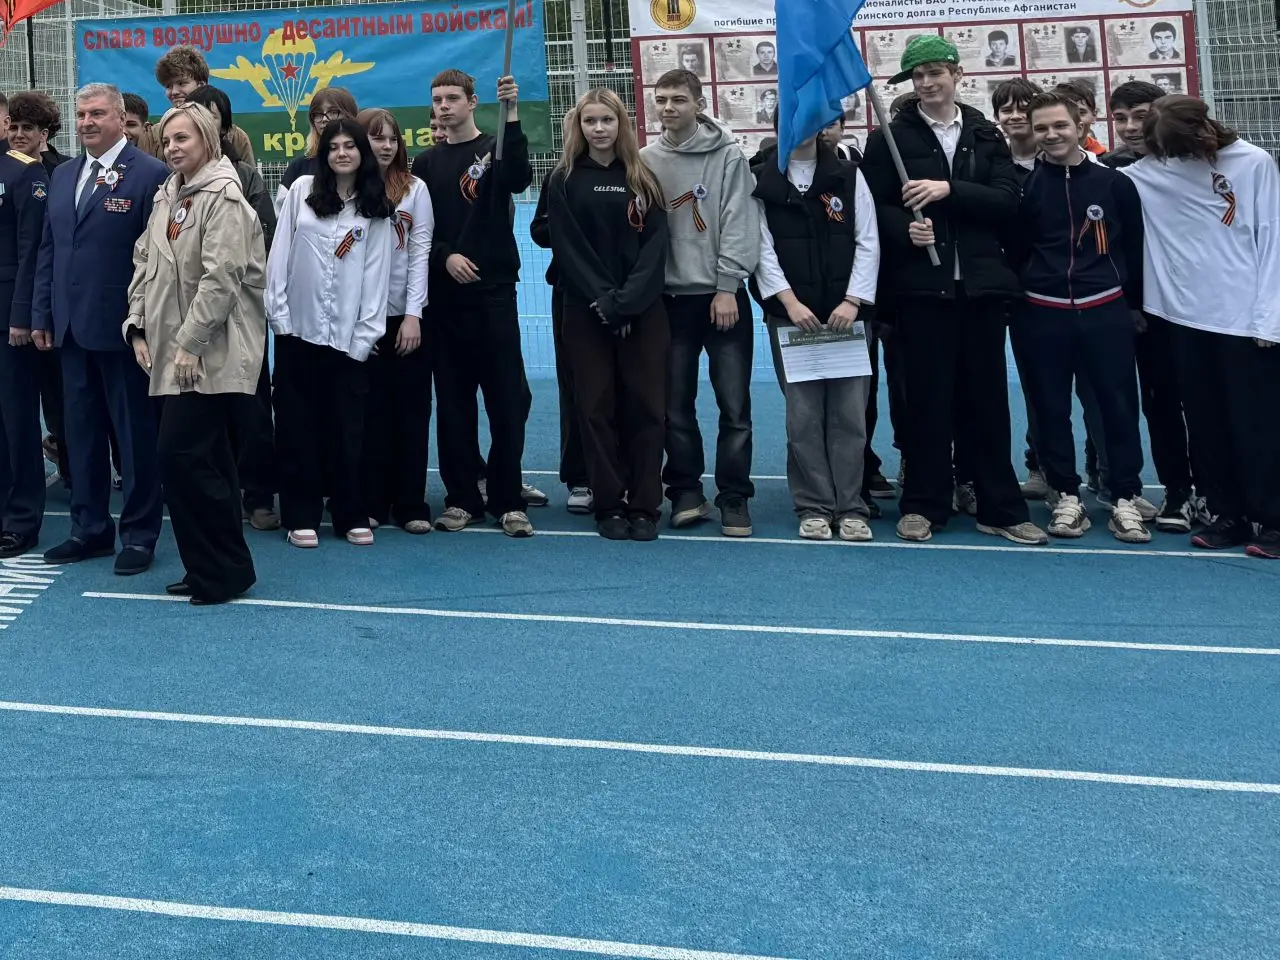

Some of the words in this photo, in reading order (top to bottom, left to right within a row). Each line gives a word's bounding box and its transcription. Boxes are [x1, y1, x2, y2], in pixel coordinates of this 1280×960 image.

[907, 9, 936, 19] долга
[948, 5, 1010, 17] Республике
[1013, 2, 1077, 14] Афганистан
[714, 17, 763, 27] погибшие
[83, 27, 145, 51] слава
[152, 22, 262, 52] воздушно
[282, 13, 413, 46] десантным
